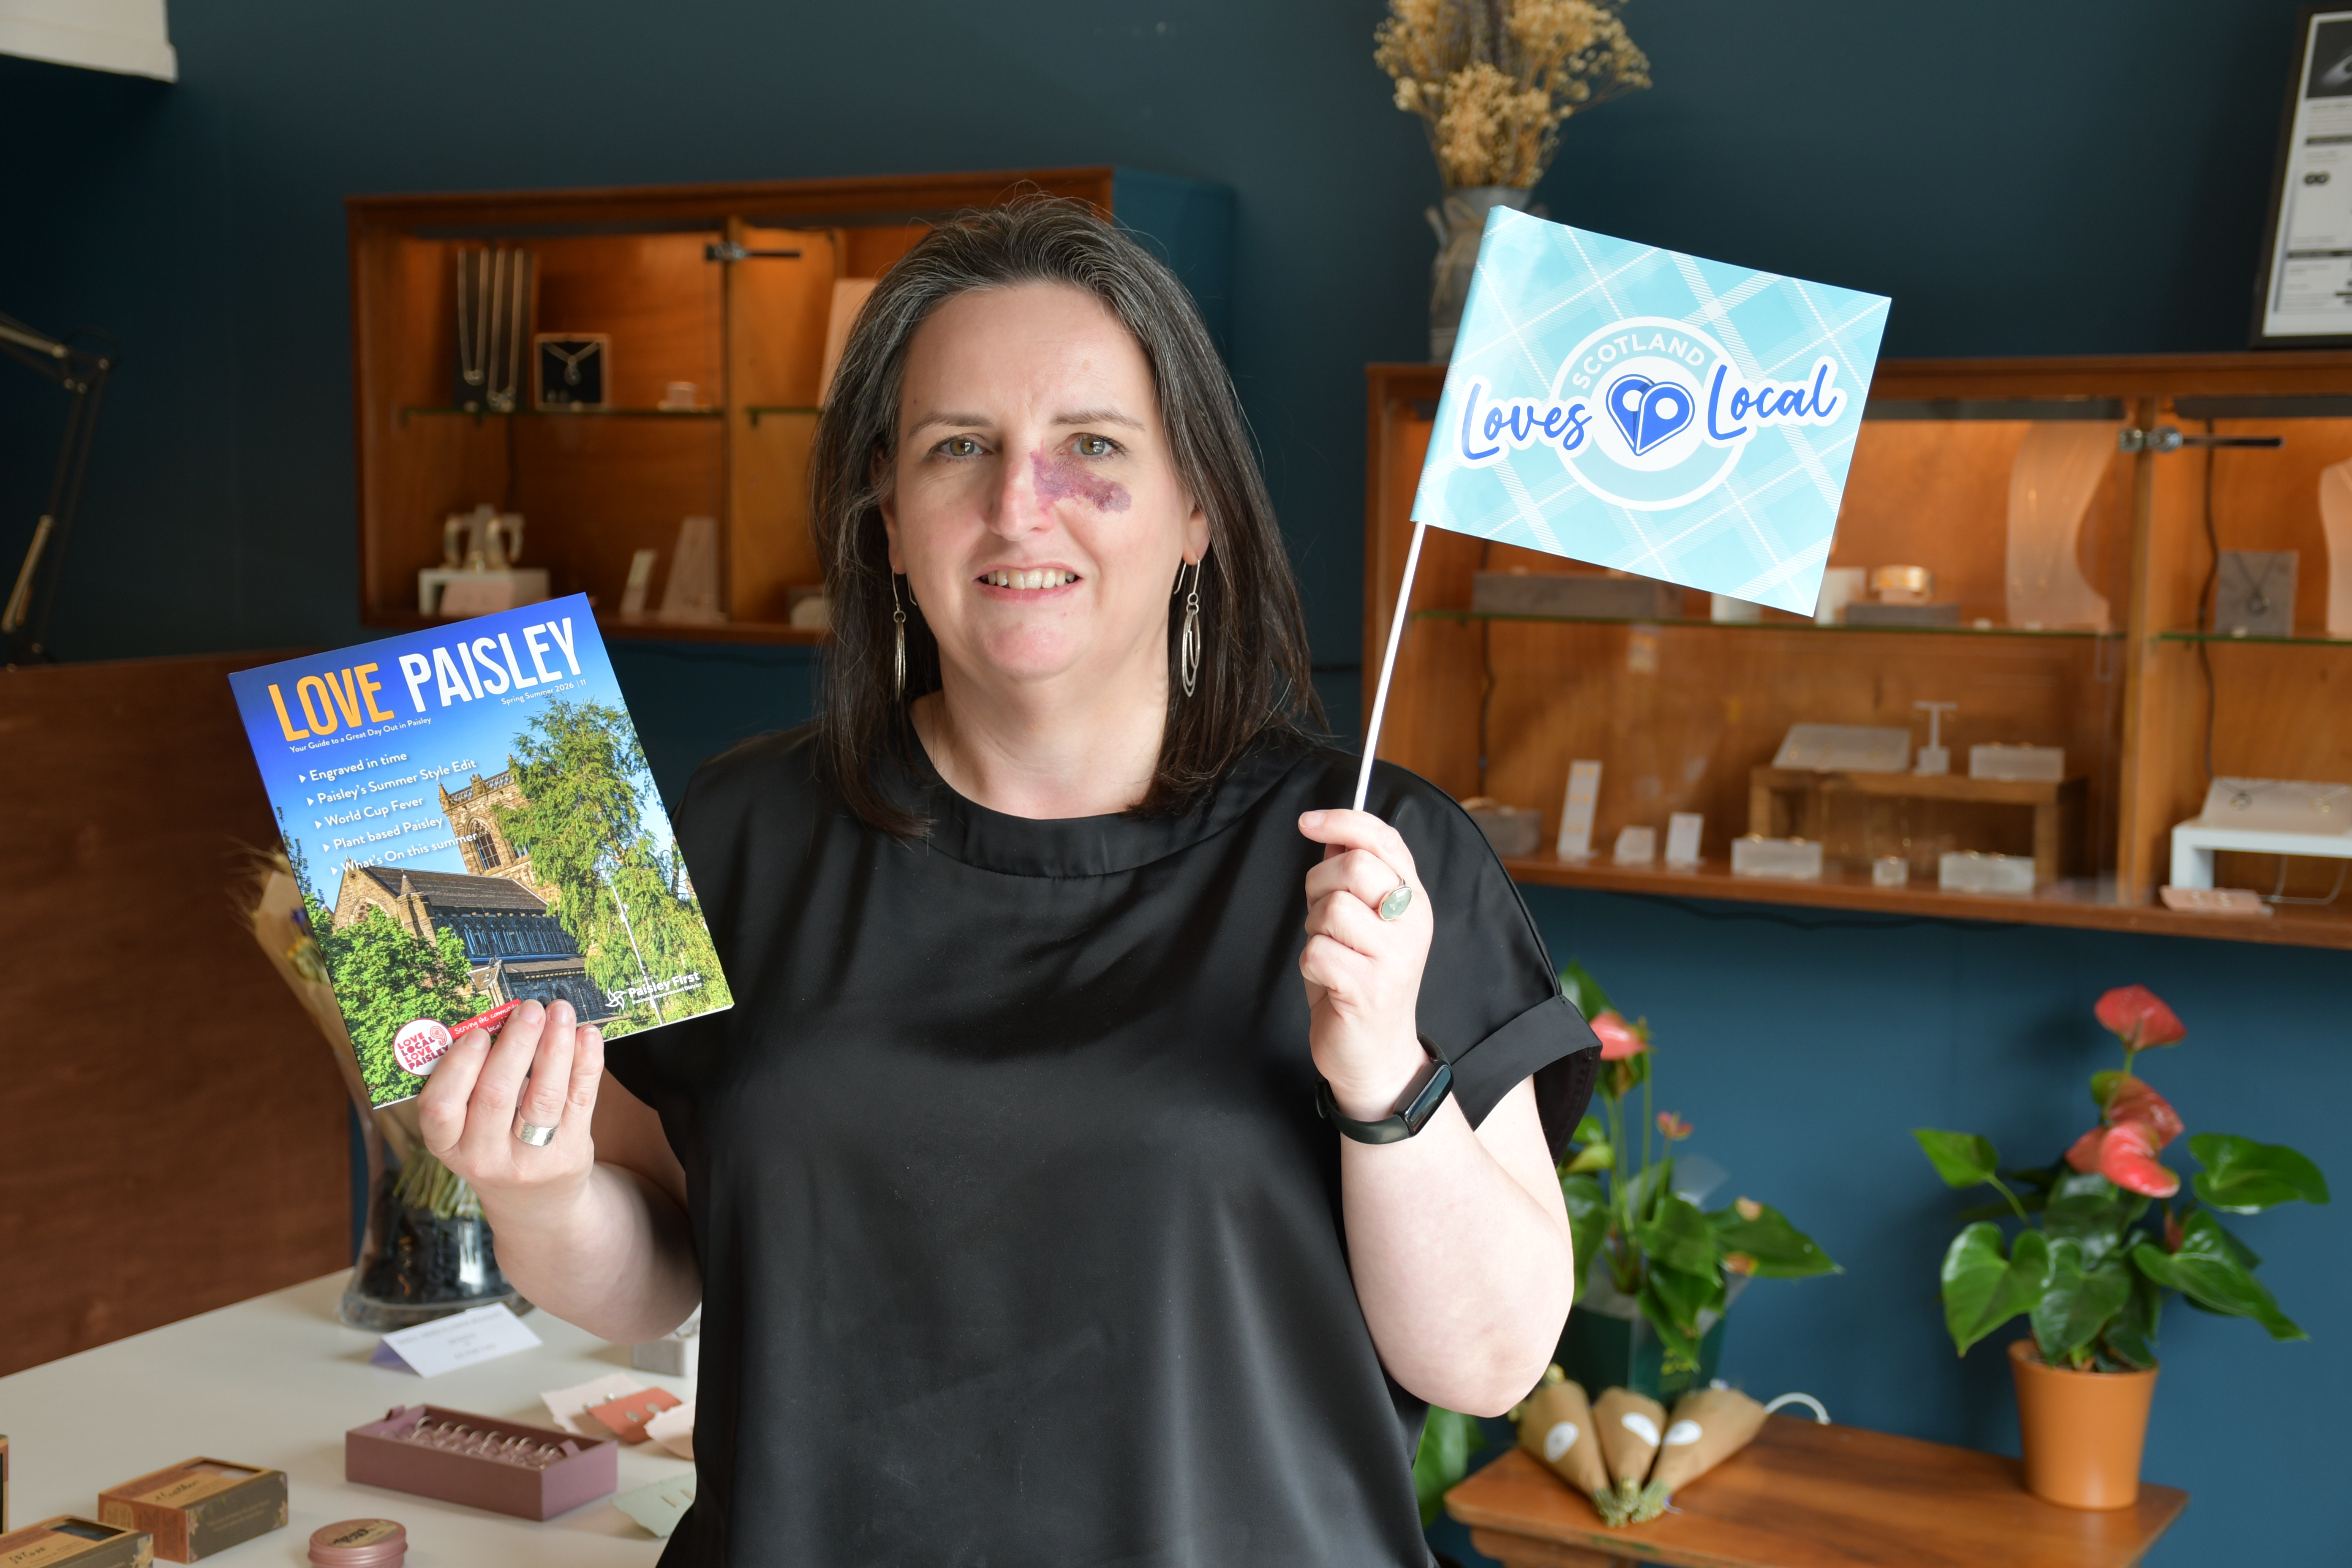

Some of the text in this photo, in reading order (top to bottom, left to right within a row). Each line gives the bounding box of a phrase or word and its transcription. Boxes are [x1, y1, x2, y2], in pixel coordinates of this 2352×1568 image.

[1572, 333, 1704, 389] SCOTLAND
[1462, 364, 1838, 460] Loves Local
[268, 617, 581, 742] LOVE PAISLEY
[501, 696, 525, 706] Spring
[525, 689, 553, 699] Summer
[554, 682, 574, 692] 2026
[308, 740, 330, 749] Guide
[346, 732, 366, 741] Great
[383, 724, 398, 732] Out
[407, 717, 431, 727] Paisley
[309, 753, 408, 781] Engraved in time
[317, 759, 477, 804] Paisley's Summer Style Edit
[324, 798, 423, 826] World Cup Fever
[333, 817, 443, 849] Plant based Paisley
[340, 833, 478, 872] What's On this summer
[628, 972, 700, 998] Paisley First
[630, 976, 653, 986] publicaon
[632, 996, 652, 1004] Busine
[653, 987, 684, 999] Improvement
[455, 1022, 479, 1034] Serving
[479, 1015, 489, 1024] the
[487, 1021, 502, 1032] local
[397, 1032, 425, 1050] LOVE
[401, 1036, 435, 1056] LOCAL
[405, 1045, 433, 1064] LOVE
[408, 1045, 449, 1070] PAISLEY
